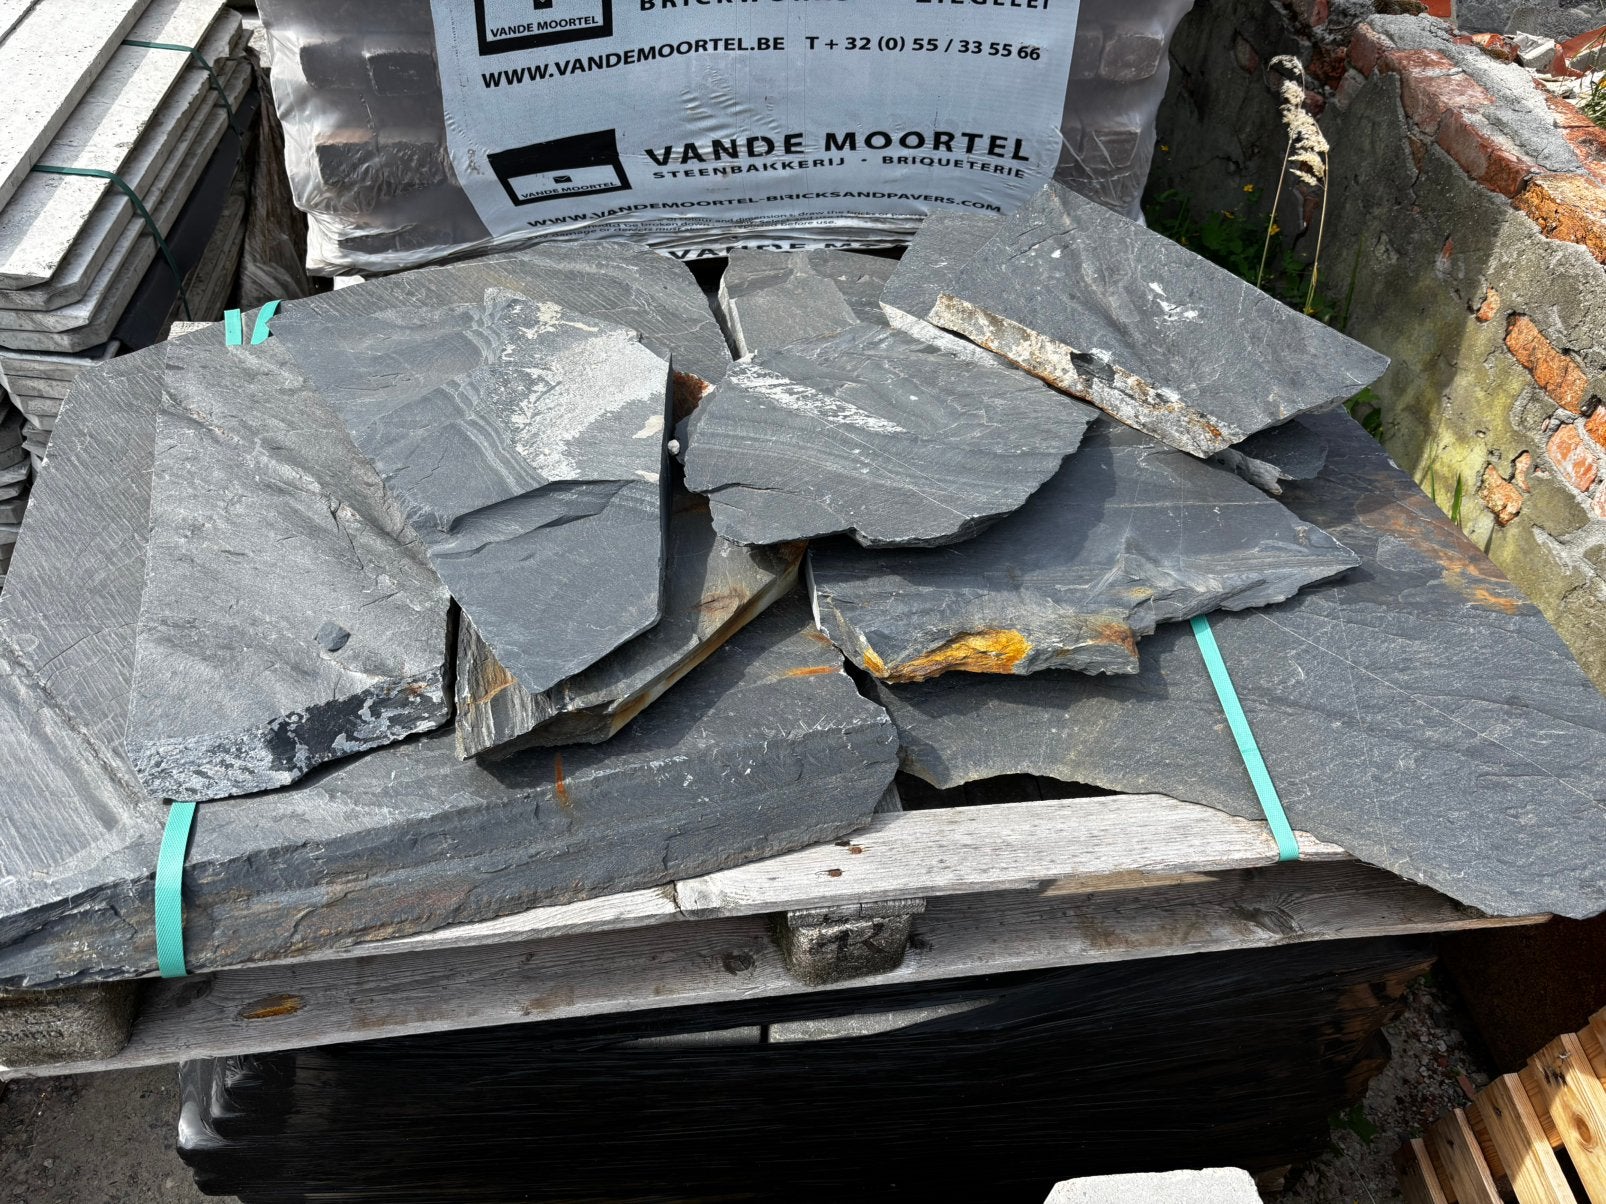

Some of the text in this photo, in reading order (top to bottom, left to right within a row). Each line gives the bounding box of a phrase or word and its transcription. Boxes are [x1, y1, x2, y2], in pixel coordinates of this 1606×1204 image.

[490, 16, 599, 38] VANDE MOORTEL
[481, 36, 786, 89] WWW.VANDEMOORTEL.BE
[804, 36, 820, 50] T
[844, 37, 872, 51] 32
[877, 36, 906, 52] (0)
[911, 38, 939, 52] 55
[957, 40, 983, 54] 33
[987, 42, 1013, 57] 55
[1016, 45, 1041, 61] 66
[643, 131, 1030, 167] VANDE MOORTEL
[652, 157, 845, 179] STEENBAKKERIJ
[882, 155, 1025, 180] BRIQUETERIE
[521, 181, 617, 199] VANDE MOORTEL
